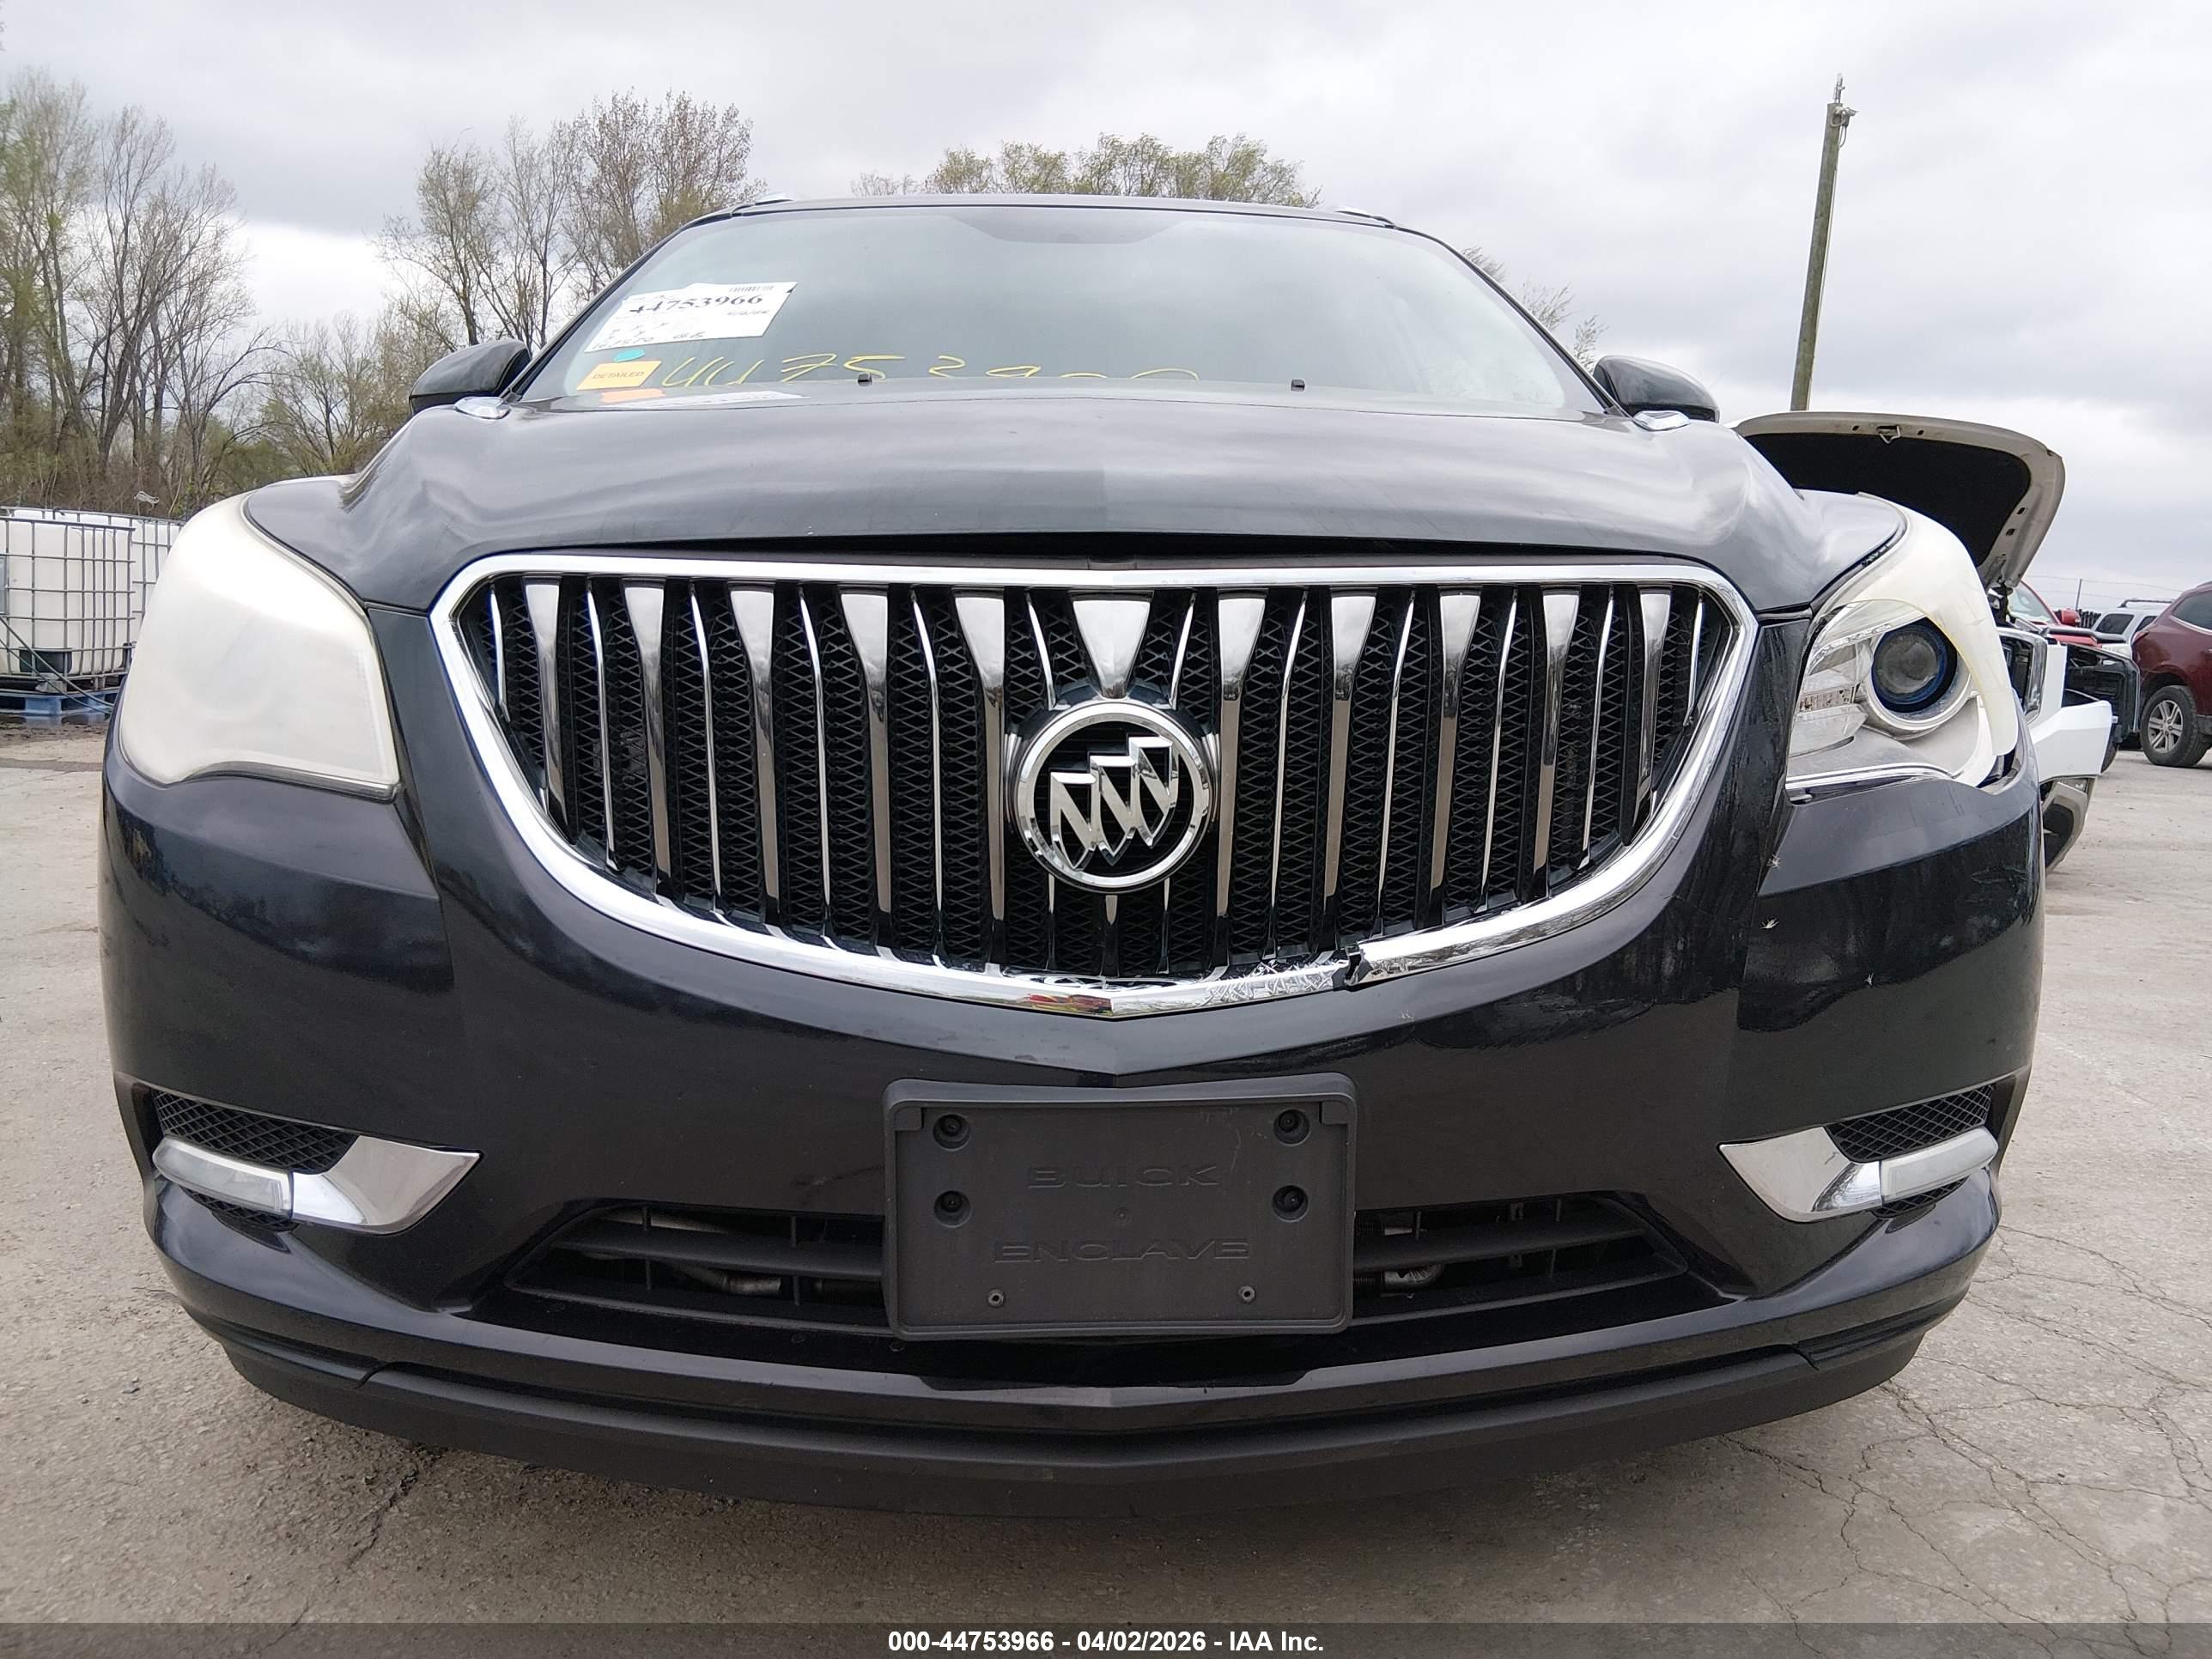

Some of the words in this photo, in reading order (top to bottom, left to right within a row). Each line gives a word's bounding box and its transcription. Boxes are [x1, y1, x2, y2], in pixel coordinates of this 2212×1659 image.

[629, 294, 763, 314] 44753966
[590, 371, 645, 380] DETAILED
[1026, 1165, 1222, 1189] BUICK
[994, 1237, 1251, 1264] ENCLAVE
